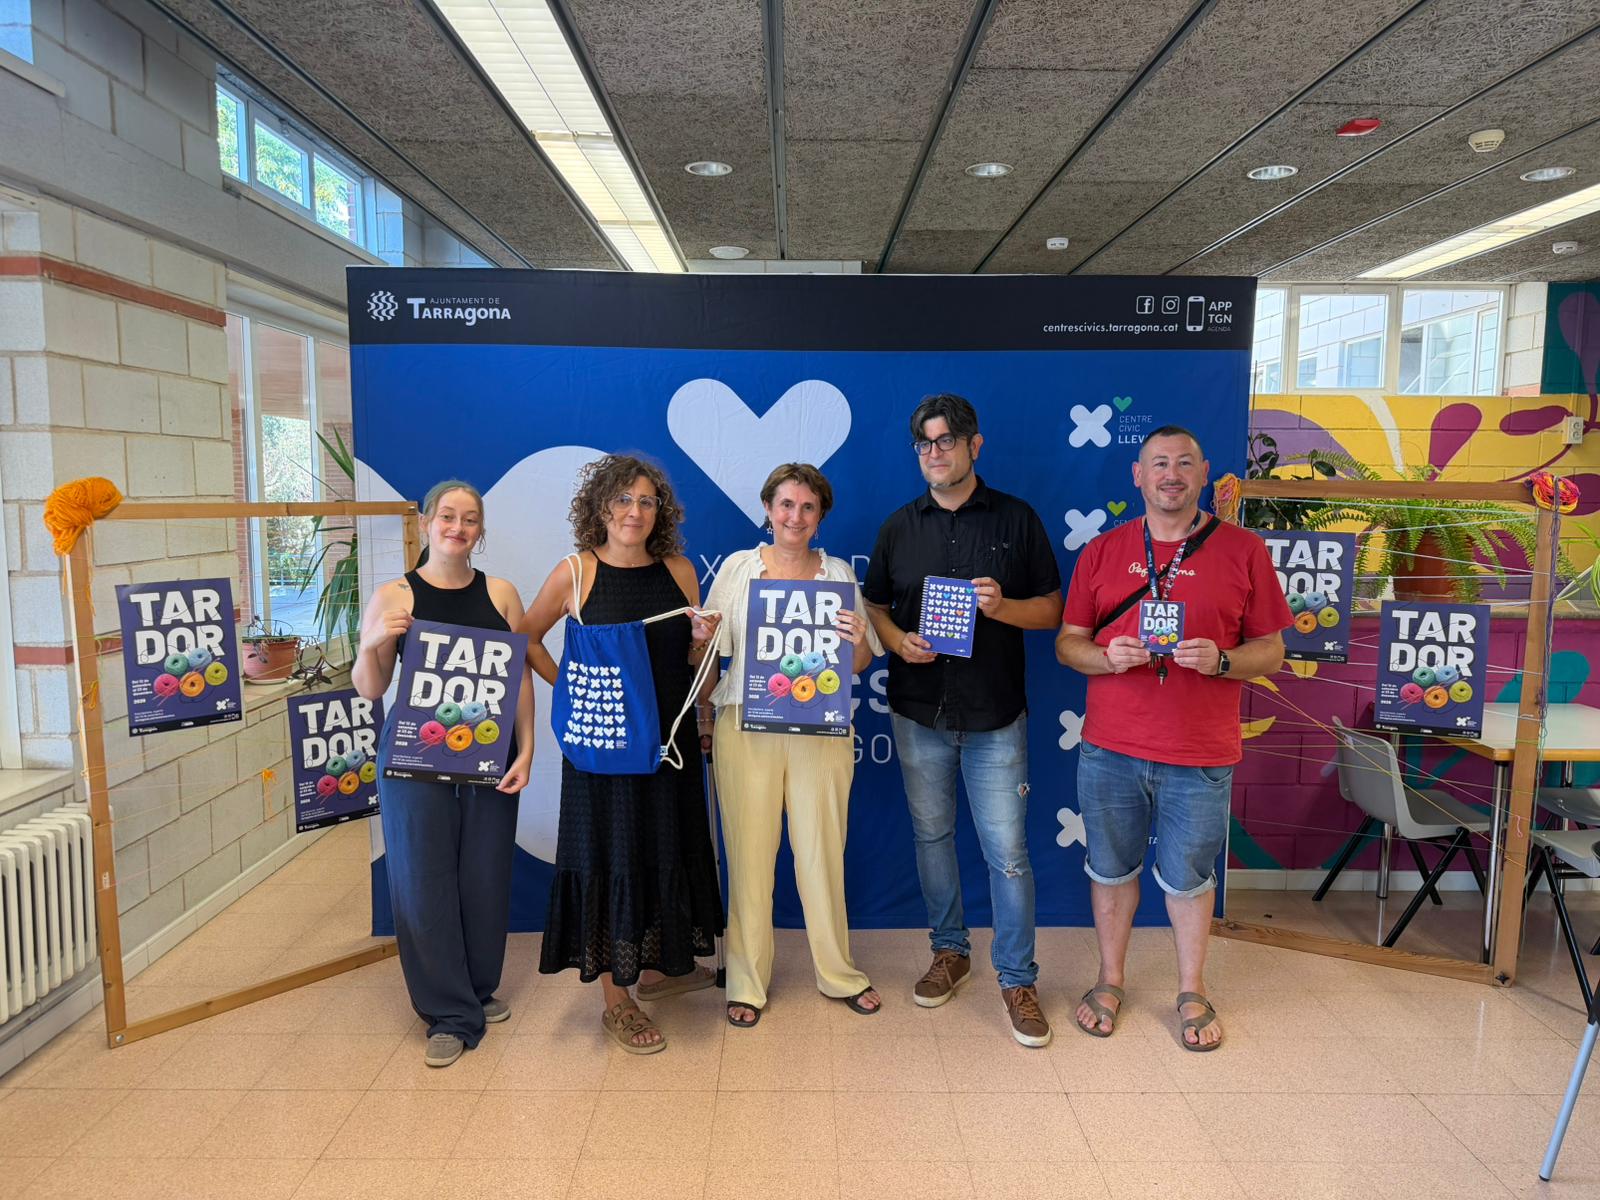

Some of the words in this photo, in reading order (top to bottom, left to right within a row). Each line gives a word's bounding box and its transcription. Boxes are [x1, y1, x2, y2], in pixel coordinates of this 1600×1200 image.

[430, 297, 484, 305] AJUNTAMENT
[489, 297, 500, 305] DE
[1208, 301, 1232, 311] APP
[1207, 314, 1232, 324] TGN
[1119, 415, 1153, 424] CENTRE
[1118, 434, 1149, 445] LLEV
[1265, 539, 1344, 570] TAR
[130, 588, 222, 627] TAR
[760, 589, 842, 625] TAR
[1143, 617, 1178, 631] DOR
[1144, 602, 1179, 617] TAR
[1392, 610, 1477, 643] TAR
[135, 624, 225, 665] DOR
[419, 632, 512, 677] TAR
[757, 626, 841, 664] DOR
[1389, 642, 1474, 677] DOR
[409, 671, 506, 715] DOR
[299, 696, 375, 735] TAR
[302, 728, 377, 769] DOR
